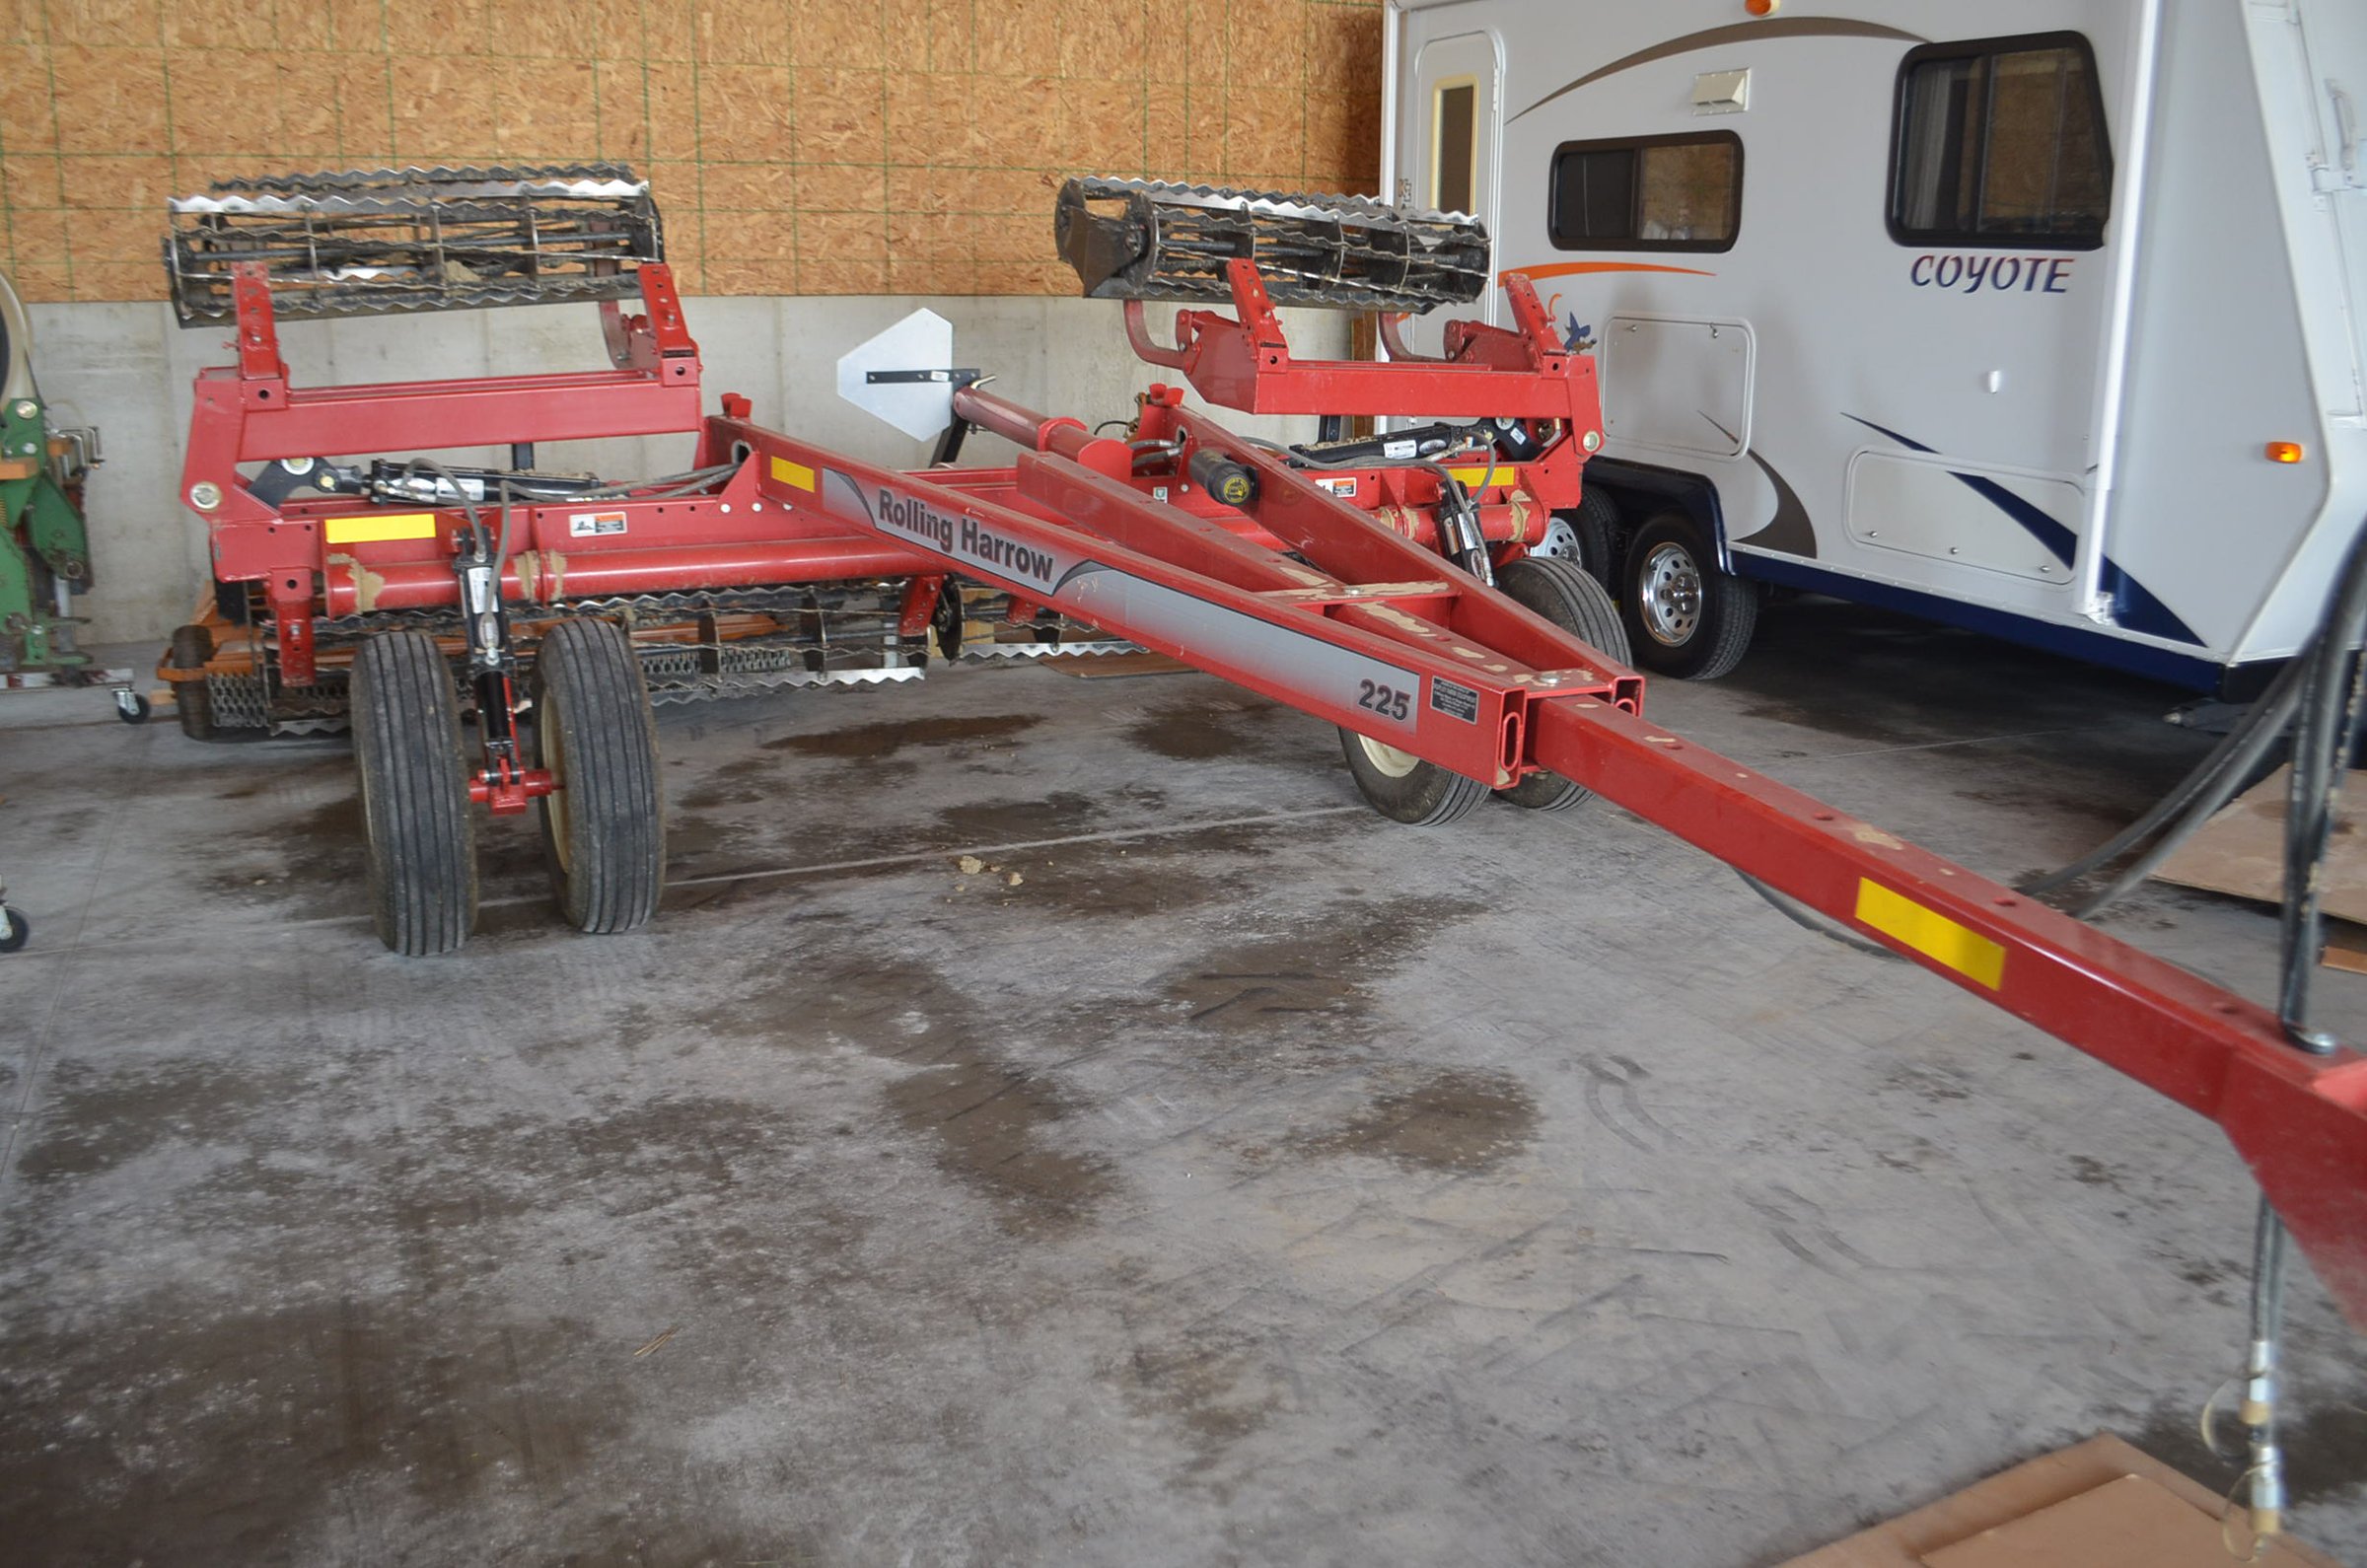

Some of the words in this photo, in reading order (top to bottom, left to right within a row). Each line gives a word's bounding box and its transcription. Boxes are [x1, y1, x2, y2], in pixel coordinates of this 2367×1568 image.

[1909, 254, 2075, 294] COYOTE
[879, 489, 954, 554] Rolling
[961, 517, 1053, 582] Harrow
[1358, 678, 1411, 721] 225
